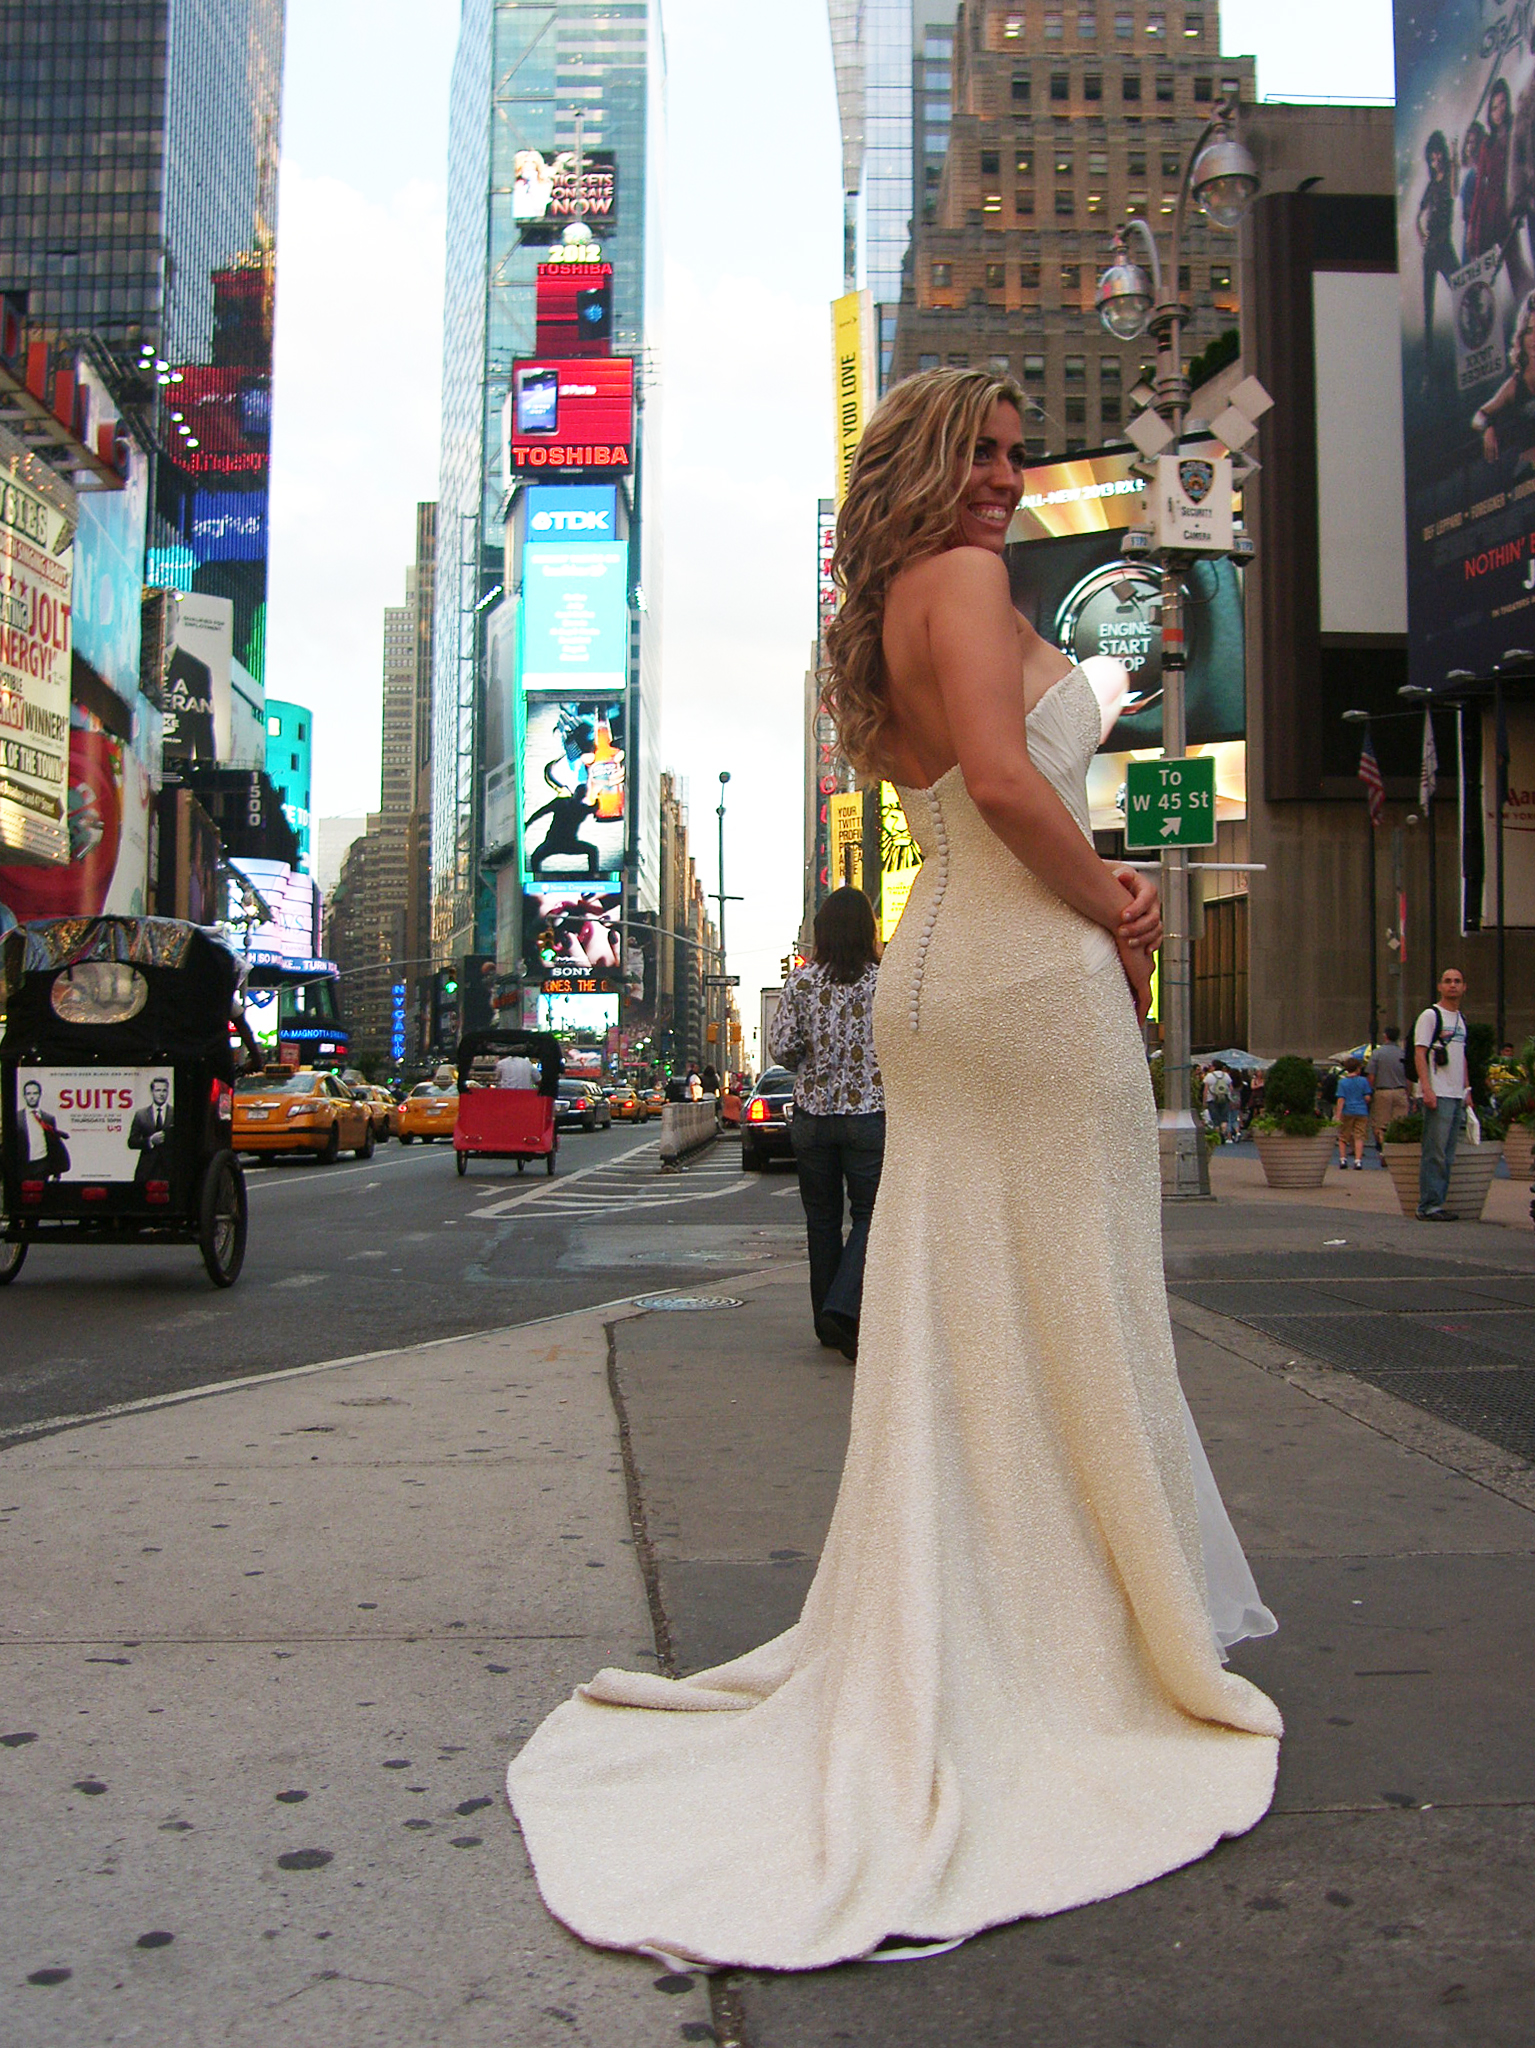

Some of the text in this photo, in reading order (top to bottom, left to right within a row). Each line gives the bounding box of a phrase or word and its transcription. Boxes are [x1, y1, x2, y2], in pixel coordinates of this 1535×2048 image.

[553, 173, 614, 187] TICKETS
[551, 187, 614, 198] ON SALE
[552, 198, 613, 216] NOW
[548, 244, 601, 263] 2012
[537, 263, 613, 276] TOSHIBA
[841, 351, 856, 398] LOVE
[842, 401, 857, 438] YOU
[512, 445, 629, 467] TOSHIBA
[549, 510, 610, 530] TDK
[1183, 530, 1212, 541] CAMERA
[1464, 536, 1525, 581] NOTHIN'
[29, 586, 72, 653] JOLT
[1098, 622, 1151, 638] ENGINE
[1098, 637, 1152, 656] START
[1132, 791, 1209, 812] W 45 St
[838, 806, 857, 818] YOUR
[552, 967, 593, 976] SONY
[577, 979, 597, 992] THE
[59, 1088, 134, 1110] SUITS
